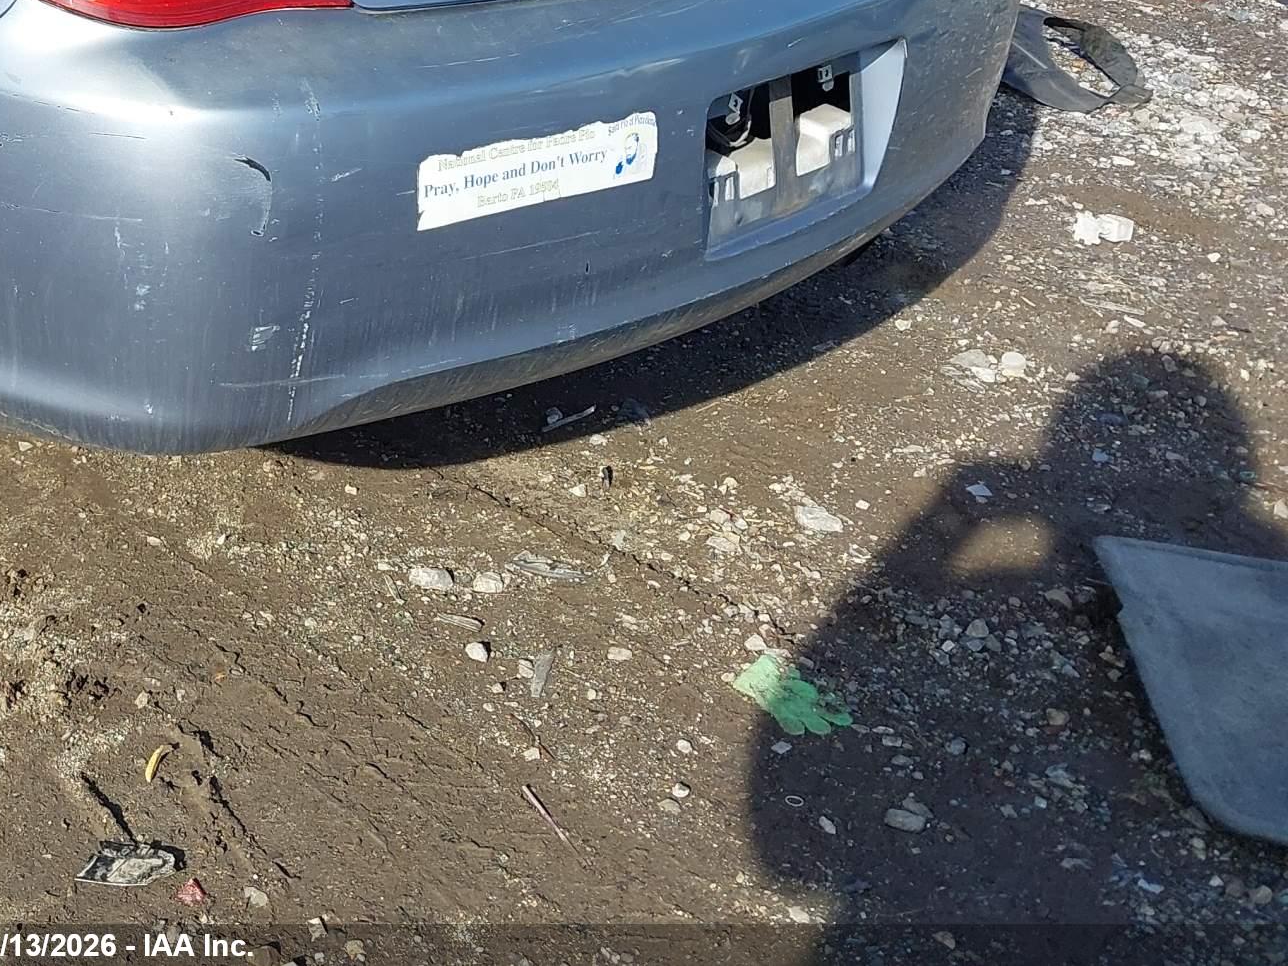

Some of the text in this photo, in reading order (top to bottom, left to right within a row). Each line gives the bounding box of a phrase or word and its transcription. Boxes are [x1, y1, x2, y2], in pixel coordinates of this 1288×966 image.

[424, 148, 608, 198] Pray, Hope and Don't Worry
